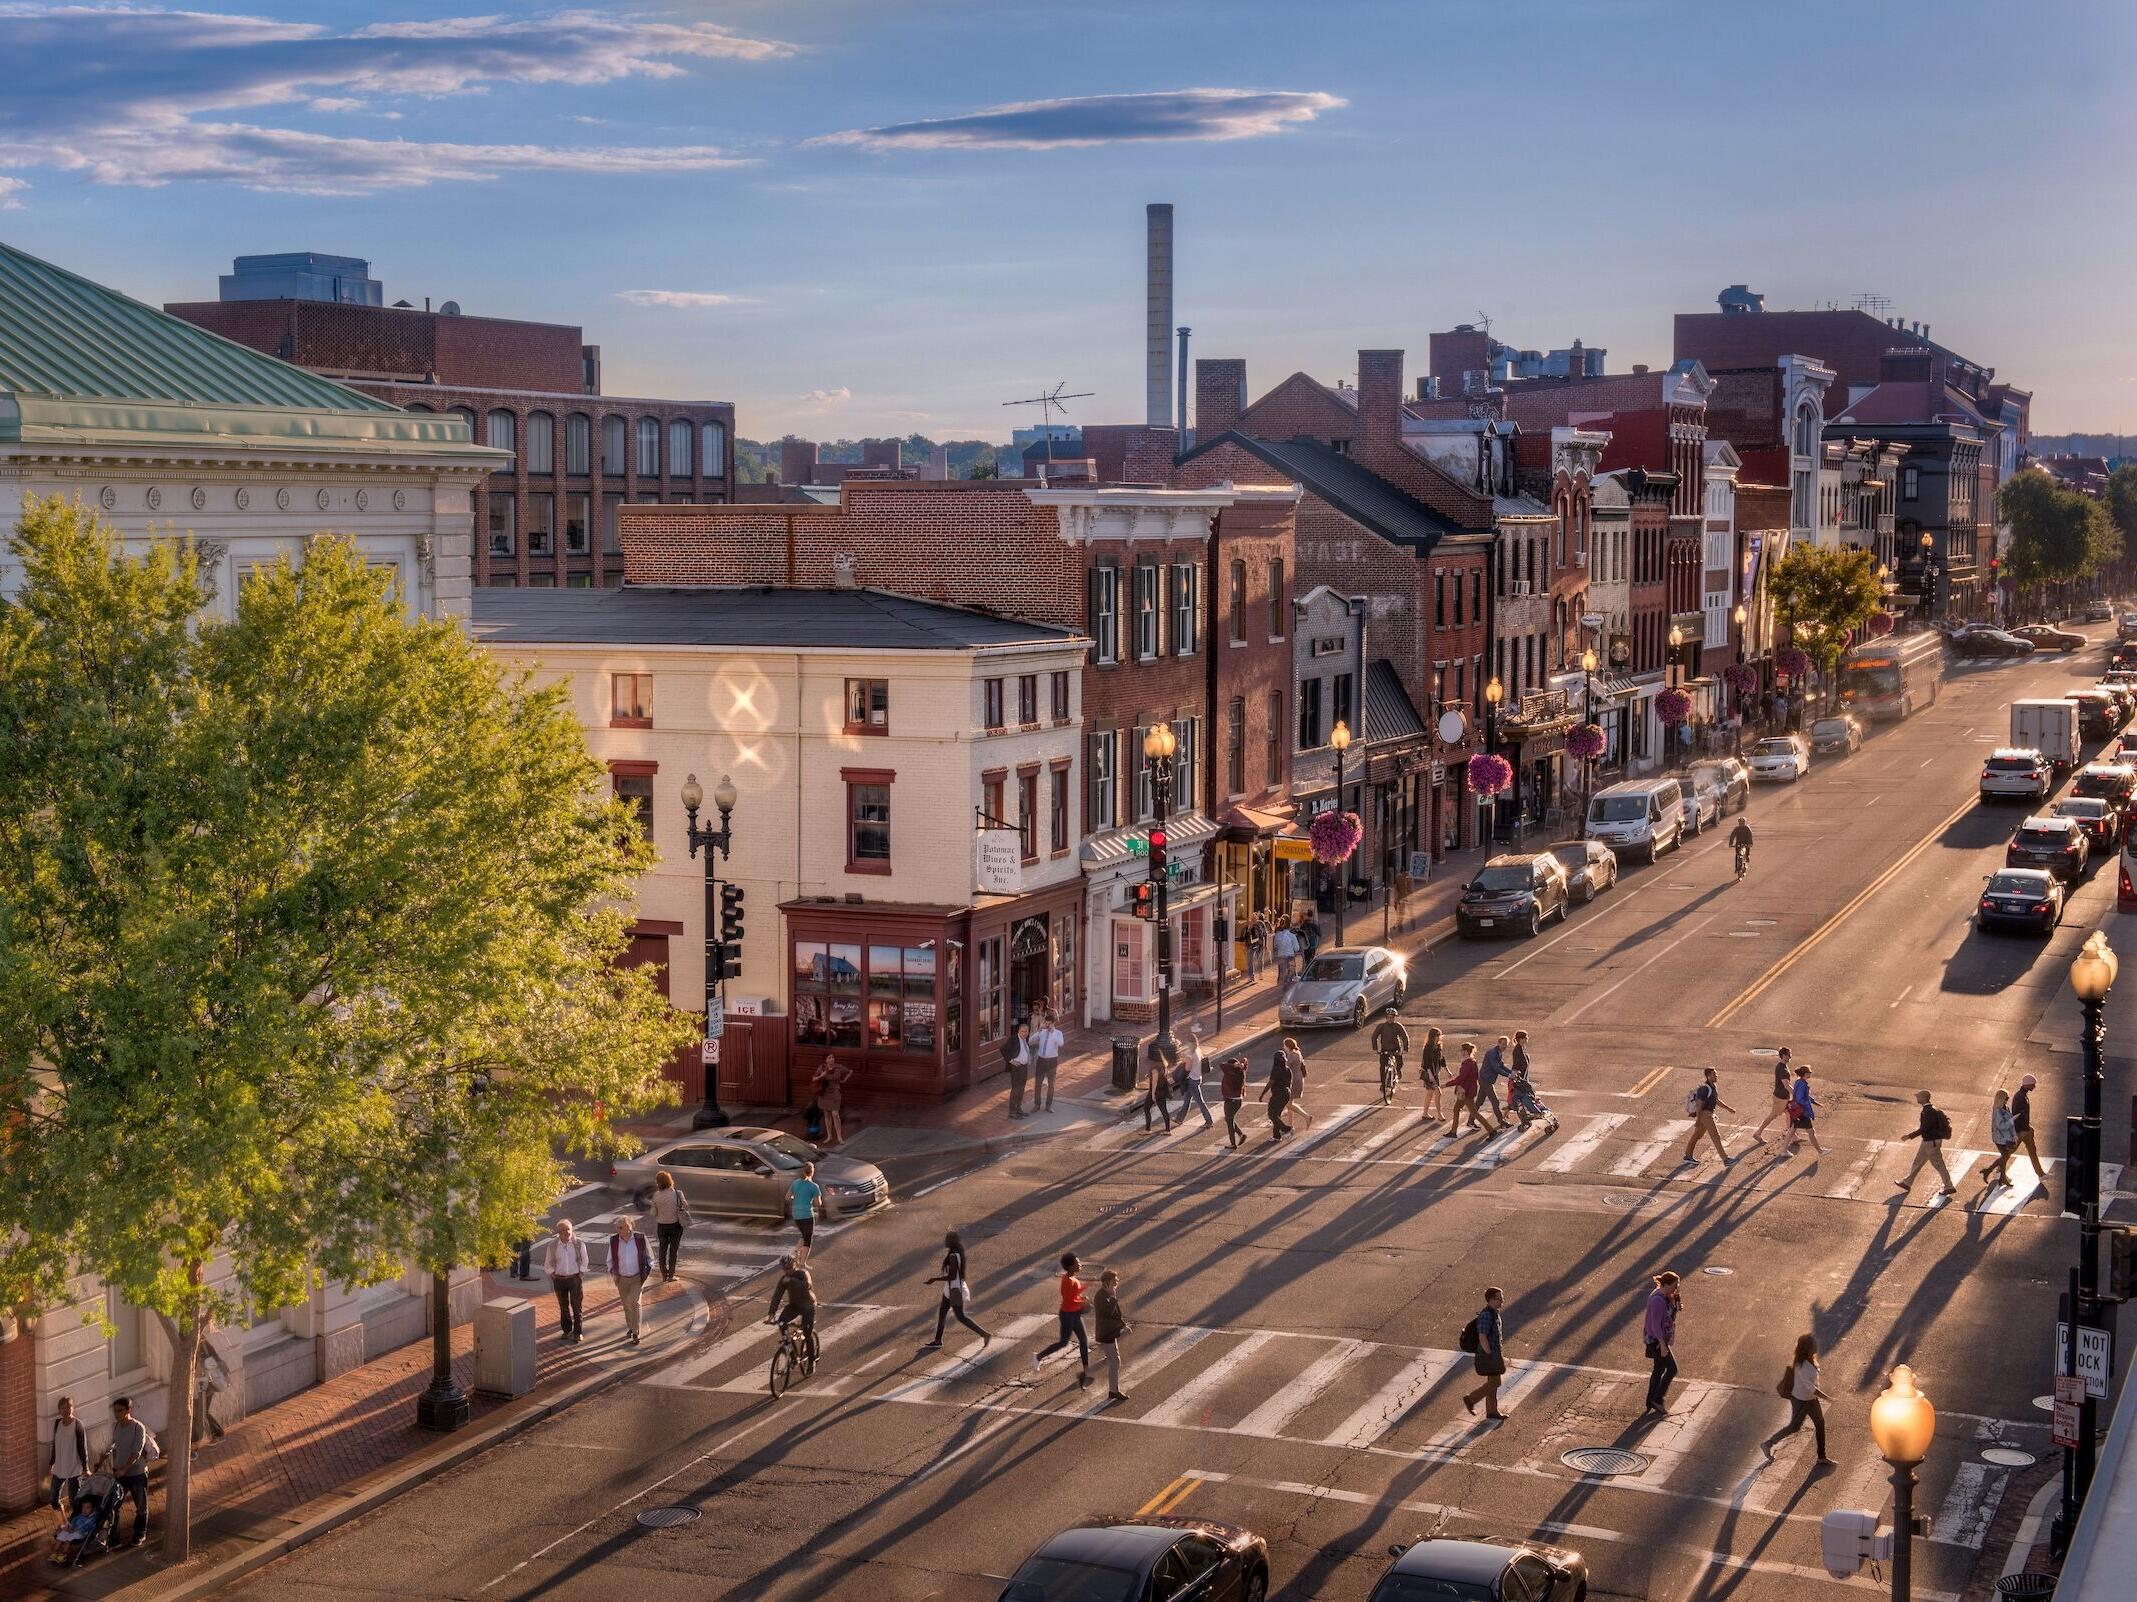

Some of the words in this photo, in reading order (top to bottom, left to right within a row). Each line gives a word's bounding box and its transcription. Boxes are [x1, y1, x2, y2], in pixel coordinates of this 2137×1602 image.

[983, 844, 1015, 854] Potomac
[983, 854, 1007, 863] Wines
[1010, 855, 1016, 864] &
[986, 865, 1016, 875] Spirits,
[993, 875, 1009, 884] Inc.
[737, 1006, 756, 1014] ICE
[2083, 1334, 2106, 1352] NOT
